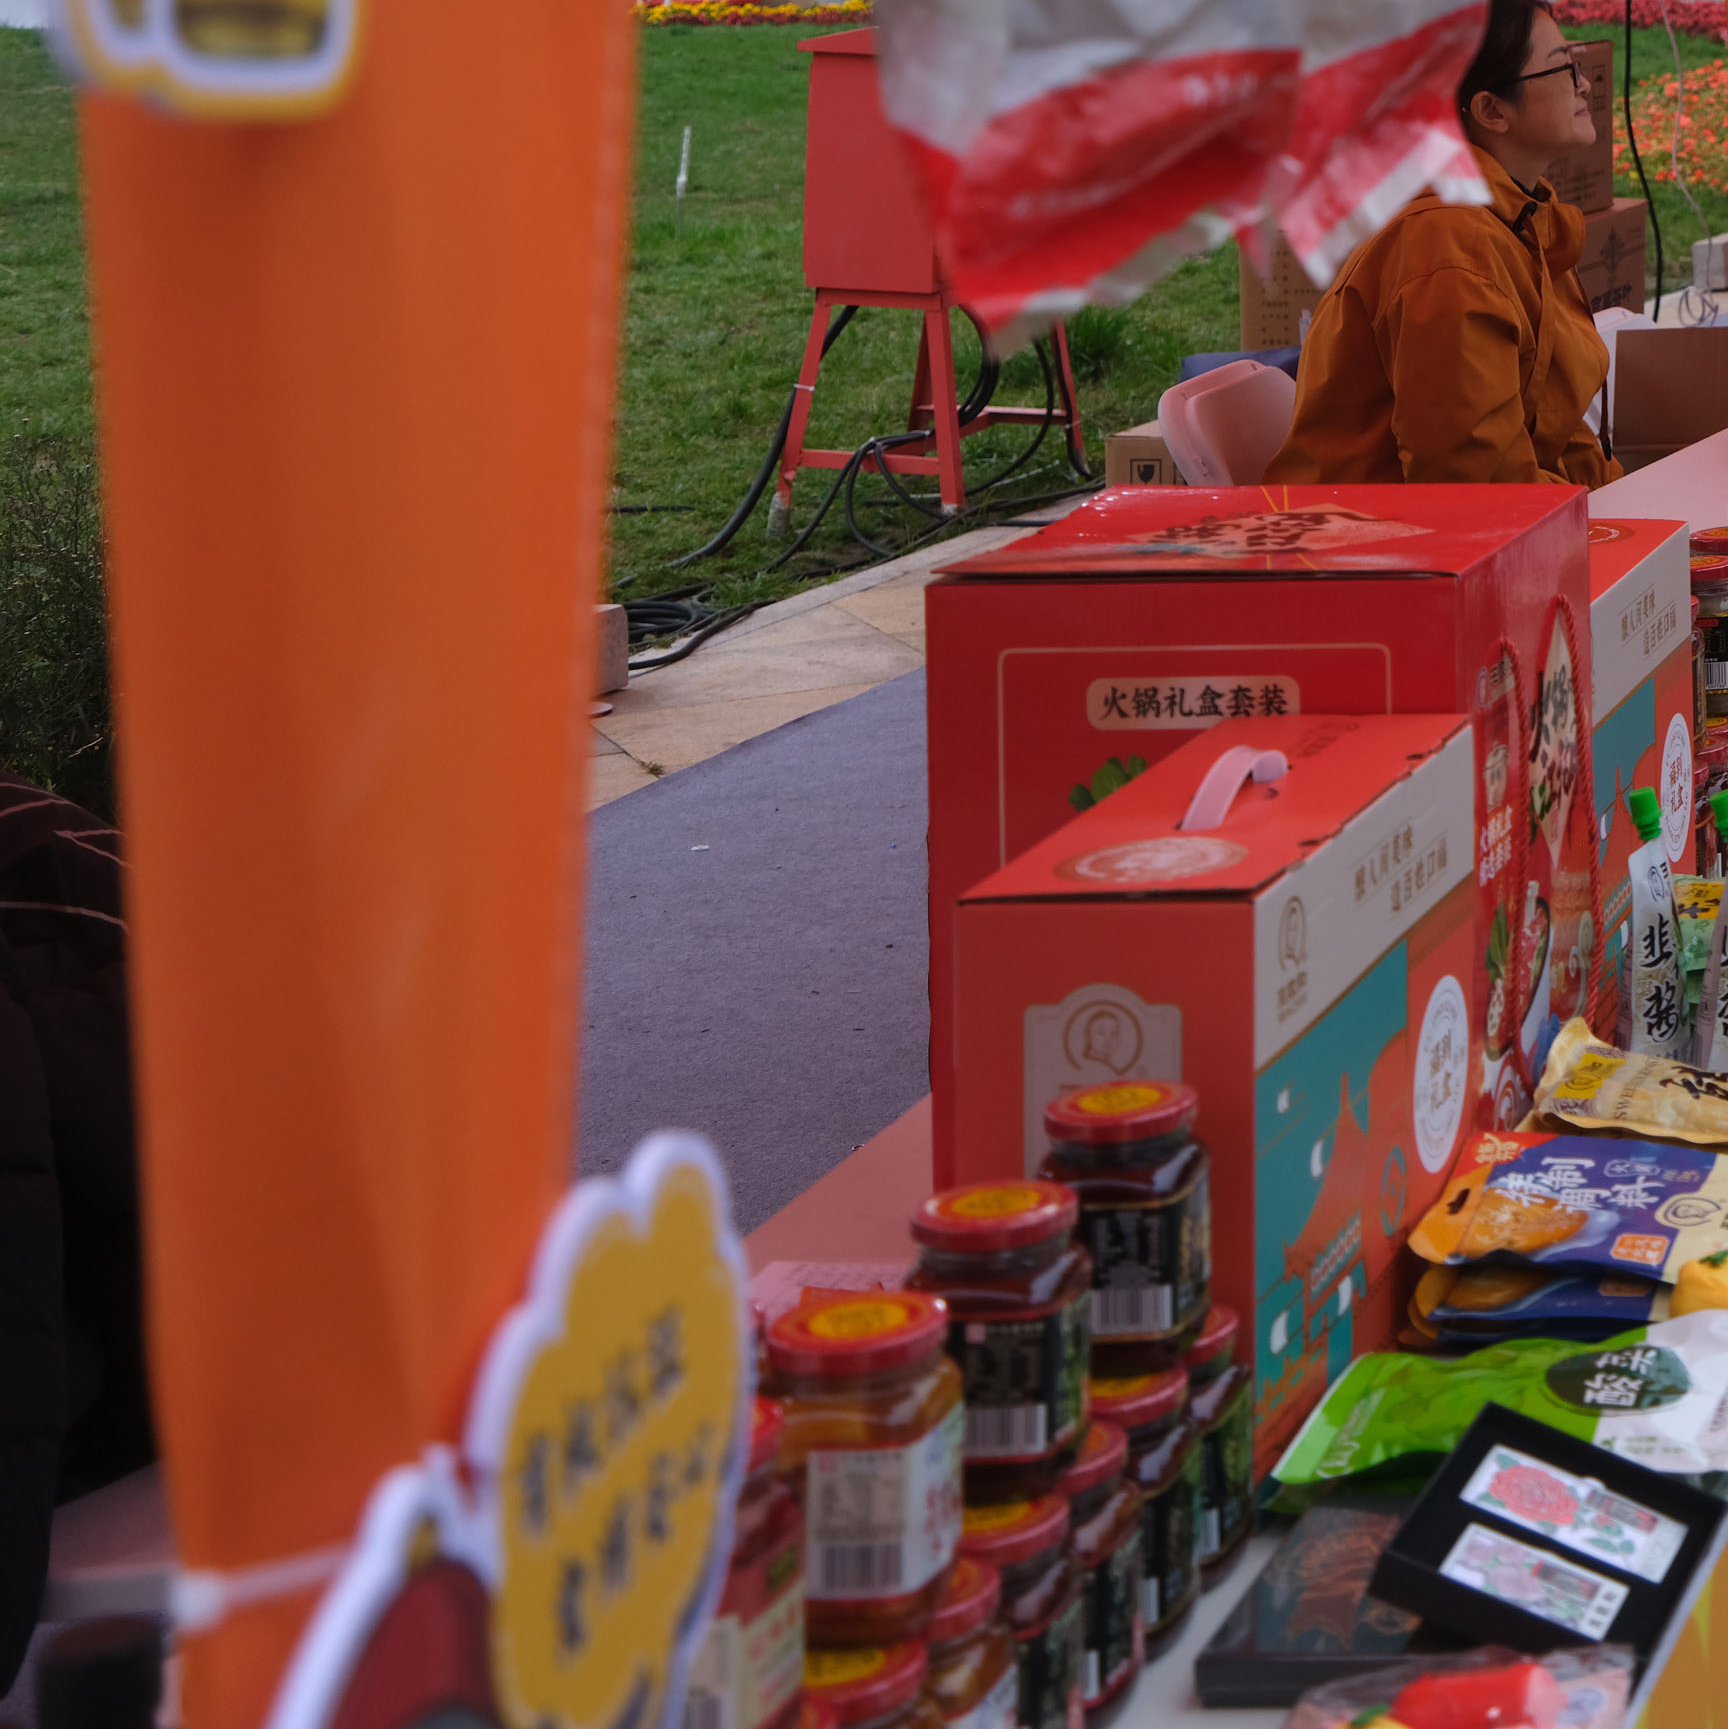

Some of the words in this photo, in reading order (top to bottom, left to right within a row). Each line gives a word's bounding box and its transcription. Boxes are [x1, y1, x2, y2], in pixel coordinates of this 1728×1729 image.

[1102, 683, 1289, 719] 火锅礼盒套装
